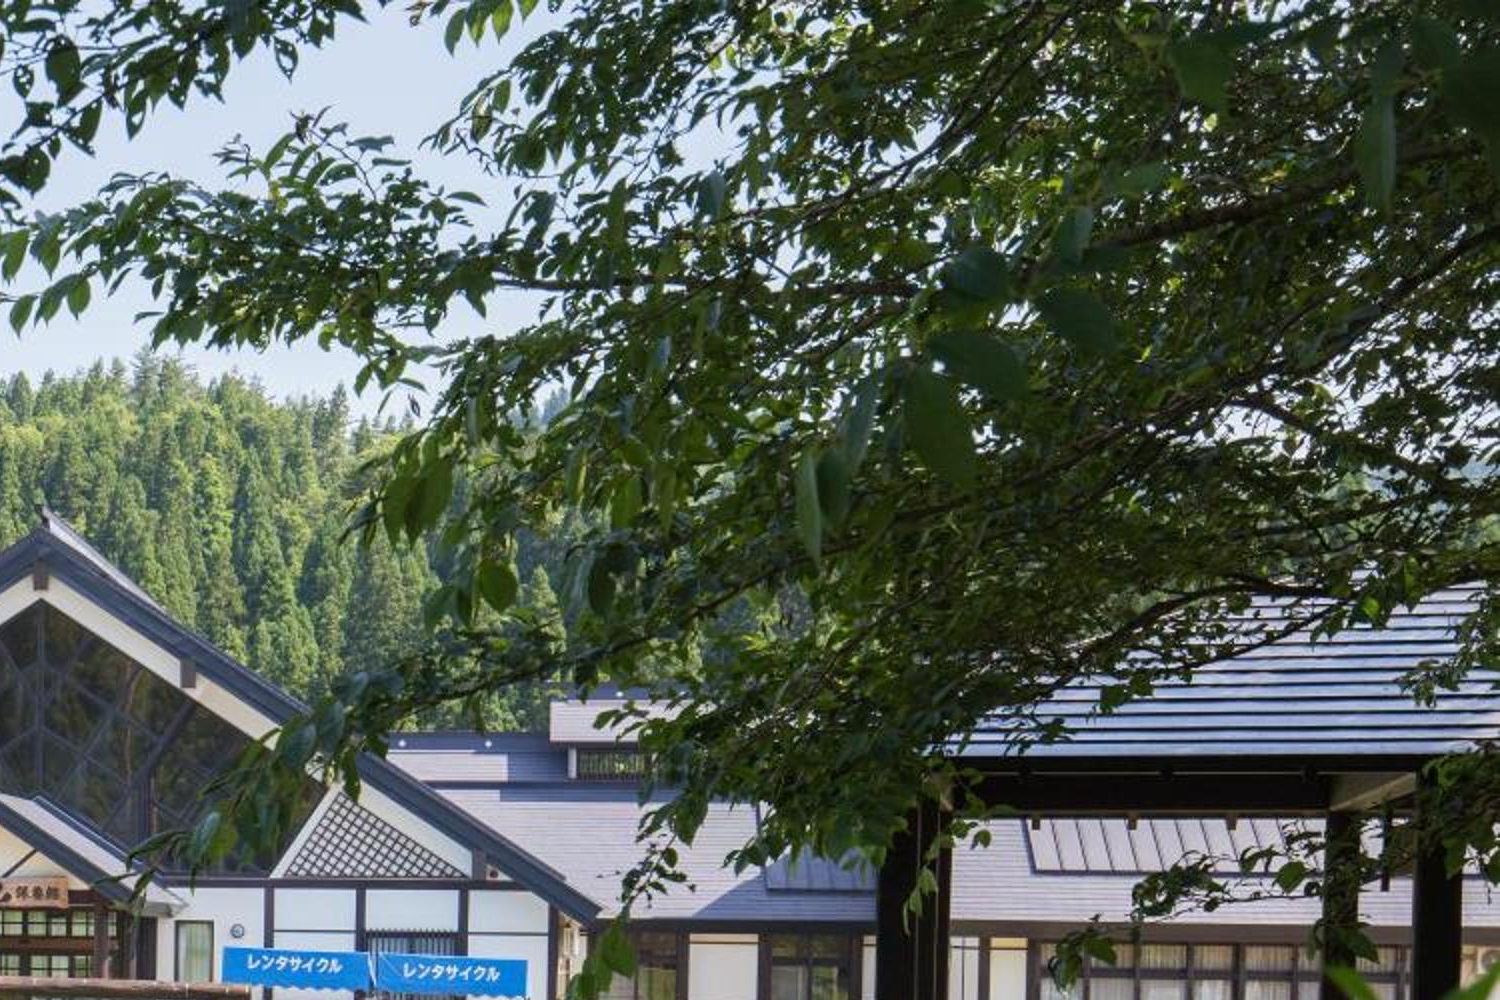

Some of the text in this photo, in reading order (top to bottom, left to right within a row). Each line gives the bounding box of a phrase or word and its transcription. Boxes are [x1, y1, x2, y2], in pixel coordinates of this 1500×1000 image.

[247, 954, 343, 974] レンタサイクル
[403, 962, 501, 982] レンタサイクル
